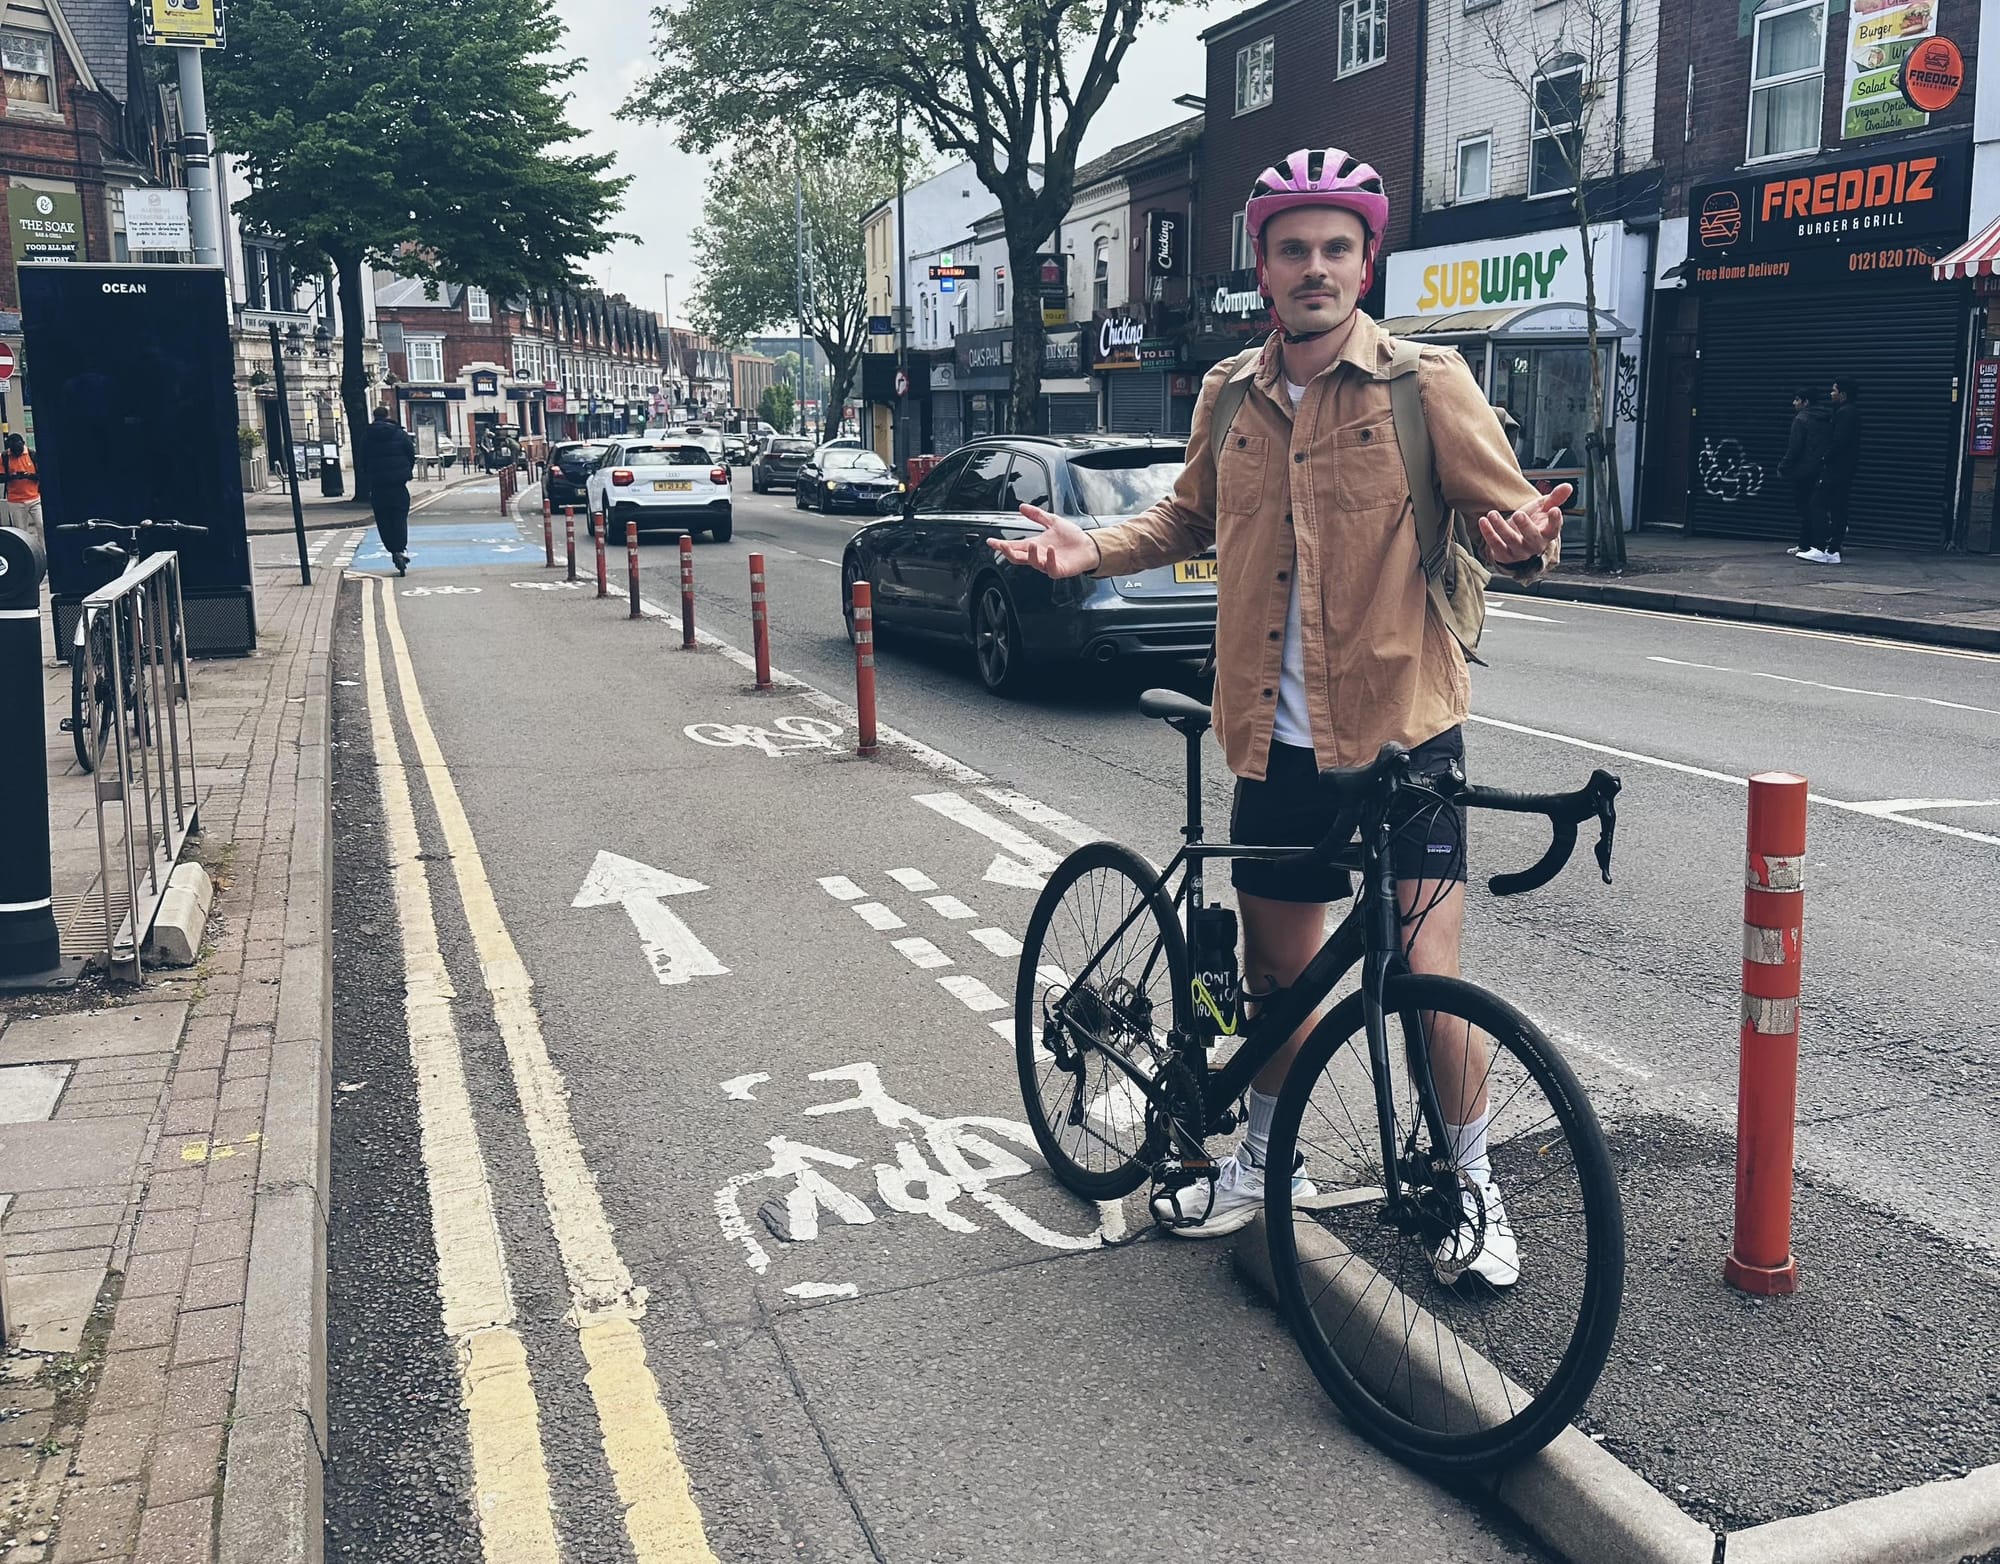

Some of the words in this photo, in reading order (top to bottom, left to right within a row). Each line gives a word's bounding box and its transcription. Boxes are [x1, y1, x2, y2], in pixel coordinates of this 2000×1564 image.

[1860, 23, 1893, 40] Burger
[1892, 46, 1910, 60] Wr
[1857, 77, 1887, 96] Salad
[1909, 69, 1960, 87] FREDDIZ
[1855, 106, 1880, 120] Vegan
[1865, 115, 1902, 132] Available
[1761, 157, 1937, 222] FREDDIZ
[20, 218, 43, 231] THE
[44, 221, 75, 233] SOAK
[1798, 219, 1848, 236] BURGER
[1853, 218, 1859, 229] &
[1864, 212, 1904, 228] GRILL
[1849, 252, 1876, 272] 0121
[1879, 249, 1902, 269] 820
[1417, 245, 1568, 312] SUBWAY
[1697, 266, 1717, 281] Free
[1719, 265, 1746, 280] Home
[1748, 262, 1790, 279] Delivery
[102, 283, 147, 293] OCEAN
[1143, 350, 1156, 358] TO
[1158, 349, 1175, 358] LET
